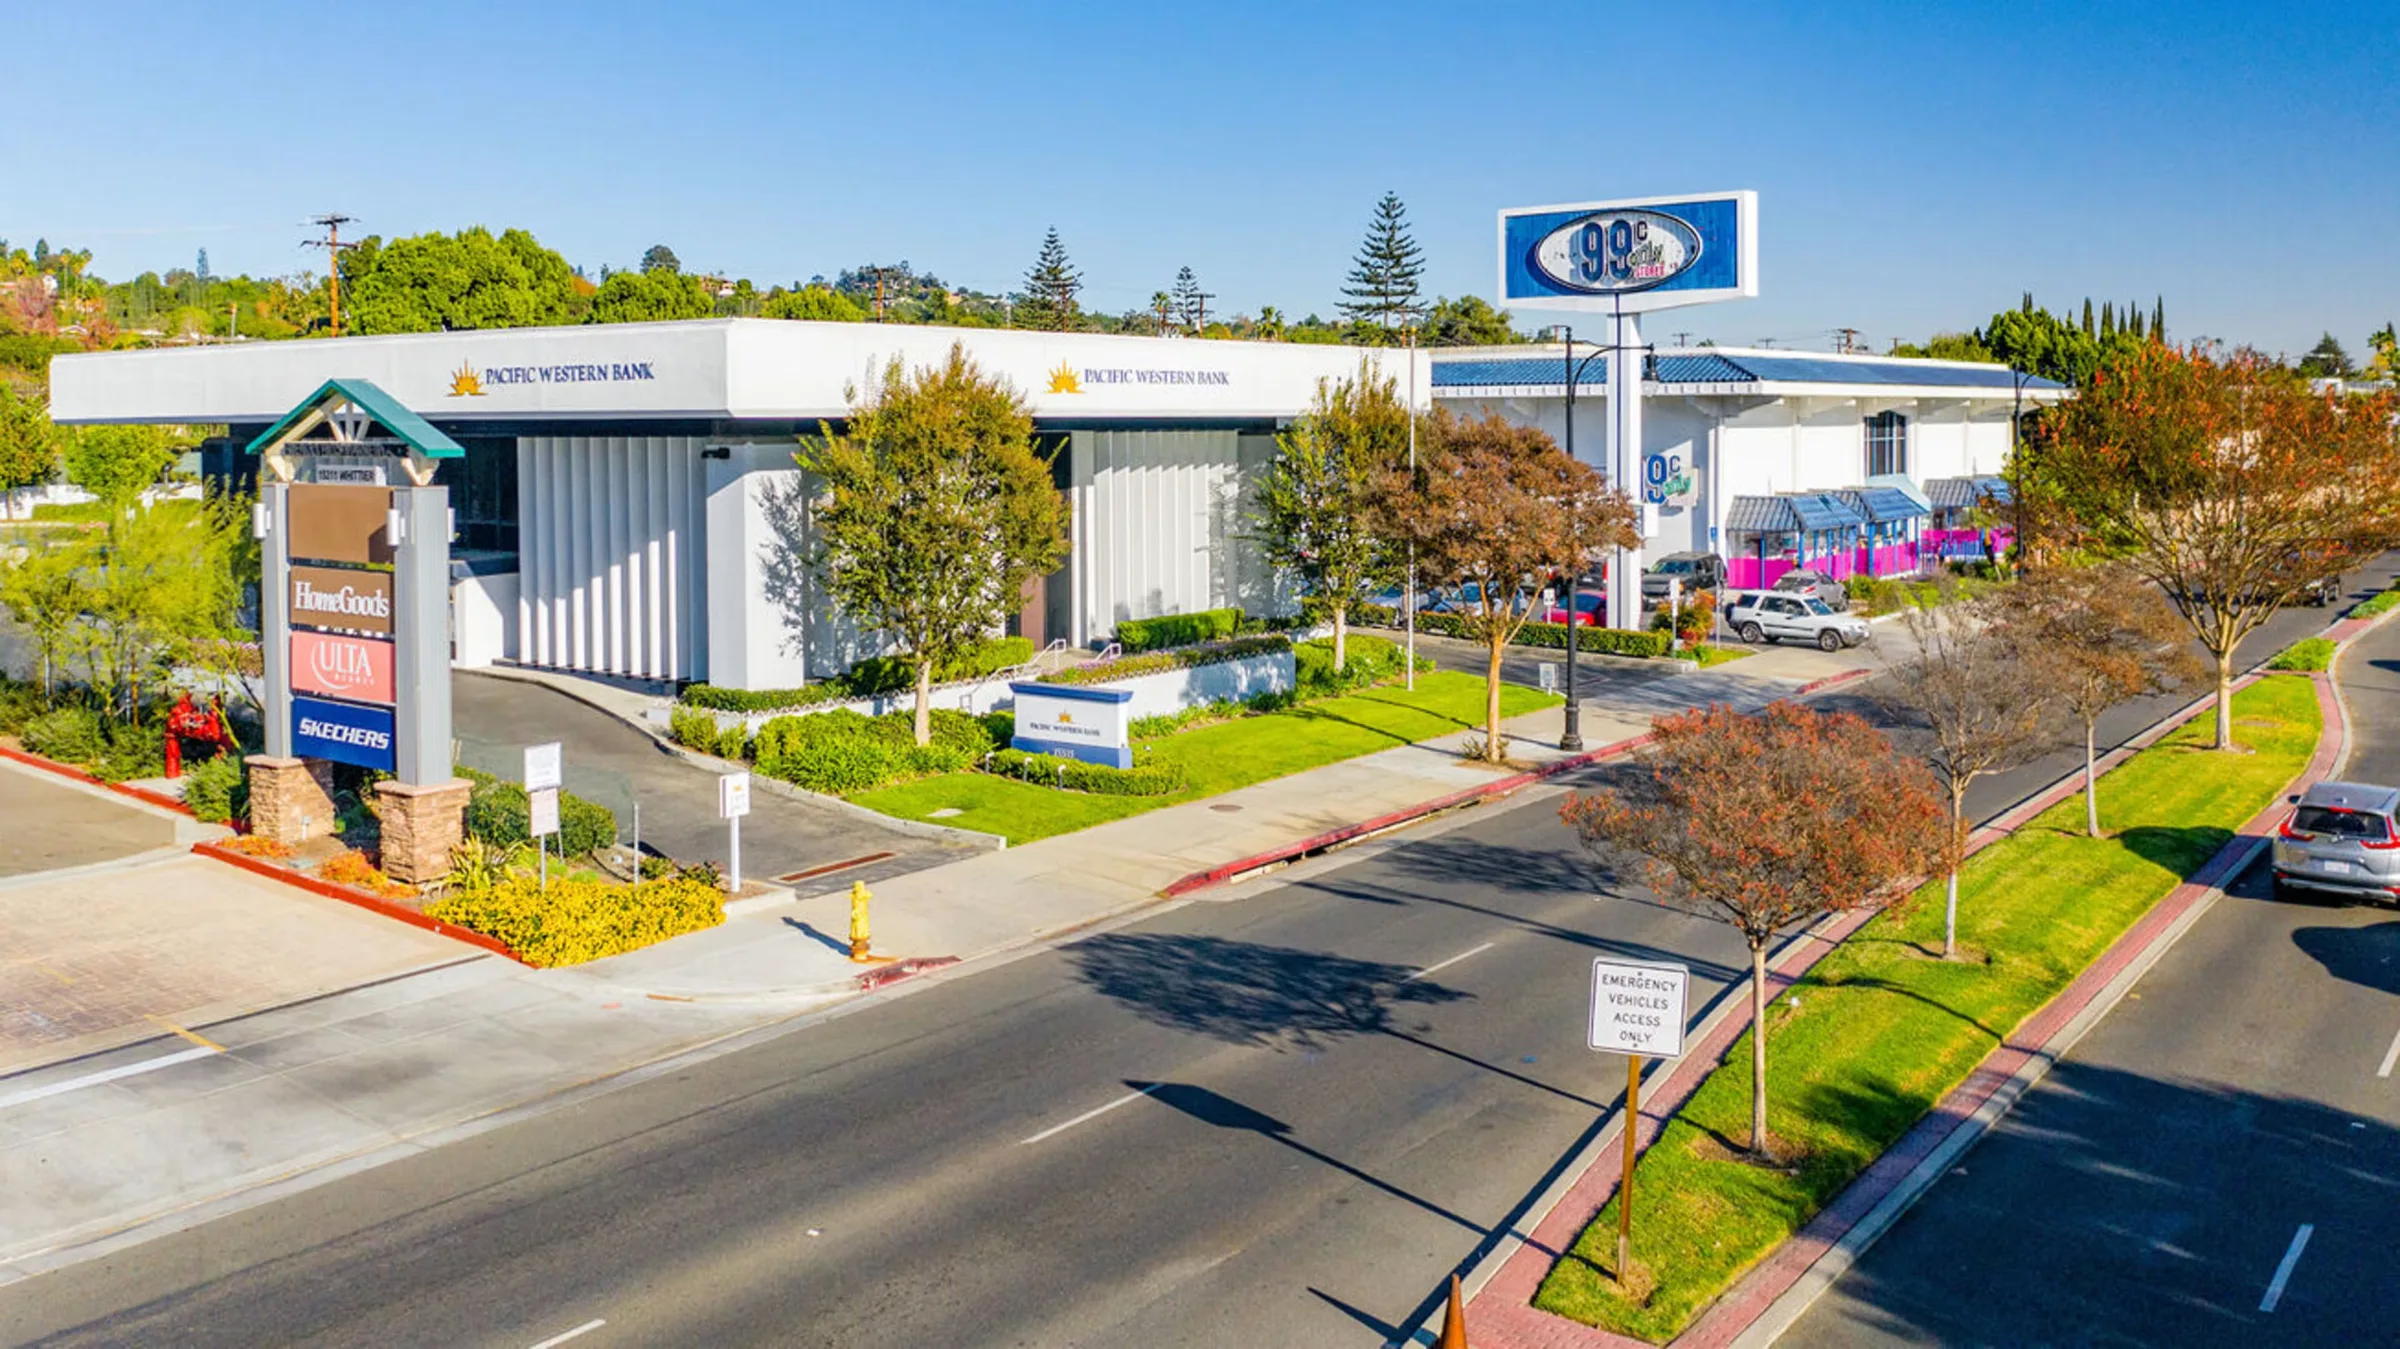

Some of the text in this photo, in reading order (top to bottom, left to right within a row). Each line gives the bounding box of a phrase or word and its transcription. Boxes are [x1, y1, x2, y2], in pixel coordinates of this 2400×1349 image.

[486, 361, 655, 385] PACIFIC WESTERN BANK
[1084, 368, 1229, 386] PACIFIC WESTERN BANK
[294, 580, 390, 618] HomeGoods
[319, 641, 373, 678] ULTA
[298, 717, 390, 750] SKECHERS
[1602, 973, 1677, 992] EMERGENCY
[1609, 993, 1669, 1010] VEHICLES
[1614, 1012, 1661, 1028] ACCESS
[1619, 1030, 1652, 1043] ONLY
